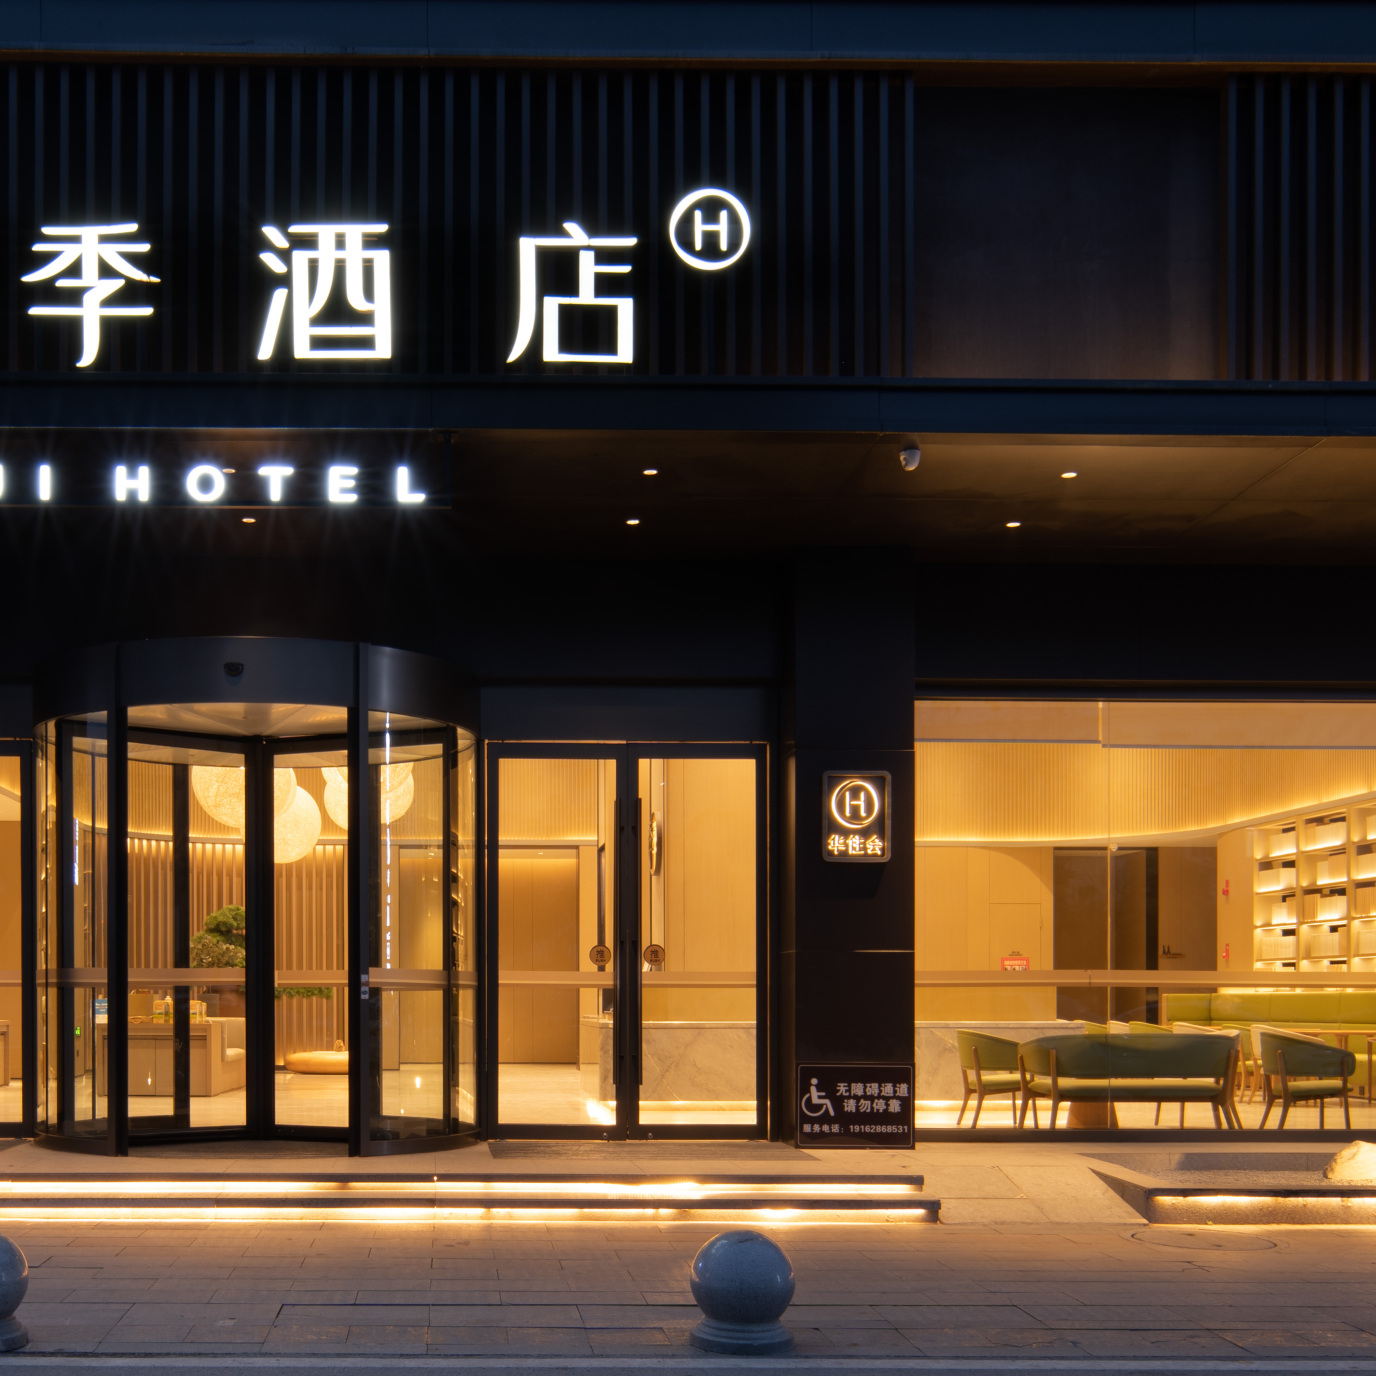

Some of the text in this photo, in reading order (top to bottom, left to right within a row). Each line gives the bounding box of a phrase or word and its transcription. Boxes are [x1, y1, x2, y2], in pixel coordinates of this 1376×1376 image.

[113, 462, 426, 503] HOTEL
[827, 834, 884, 855] 华住会
[836, 1083, 909, 1097] 无障碍通道
[843, 1099, 902, 1113] 请勿停靠
[849, 1125, 908, 1133] 19162868531
